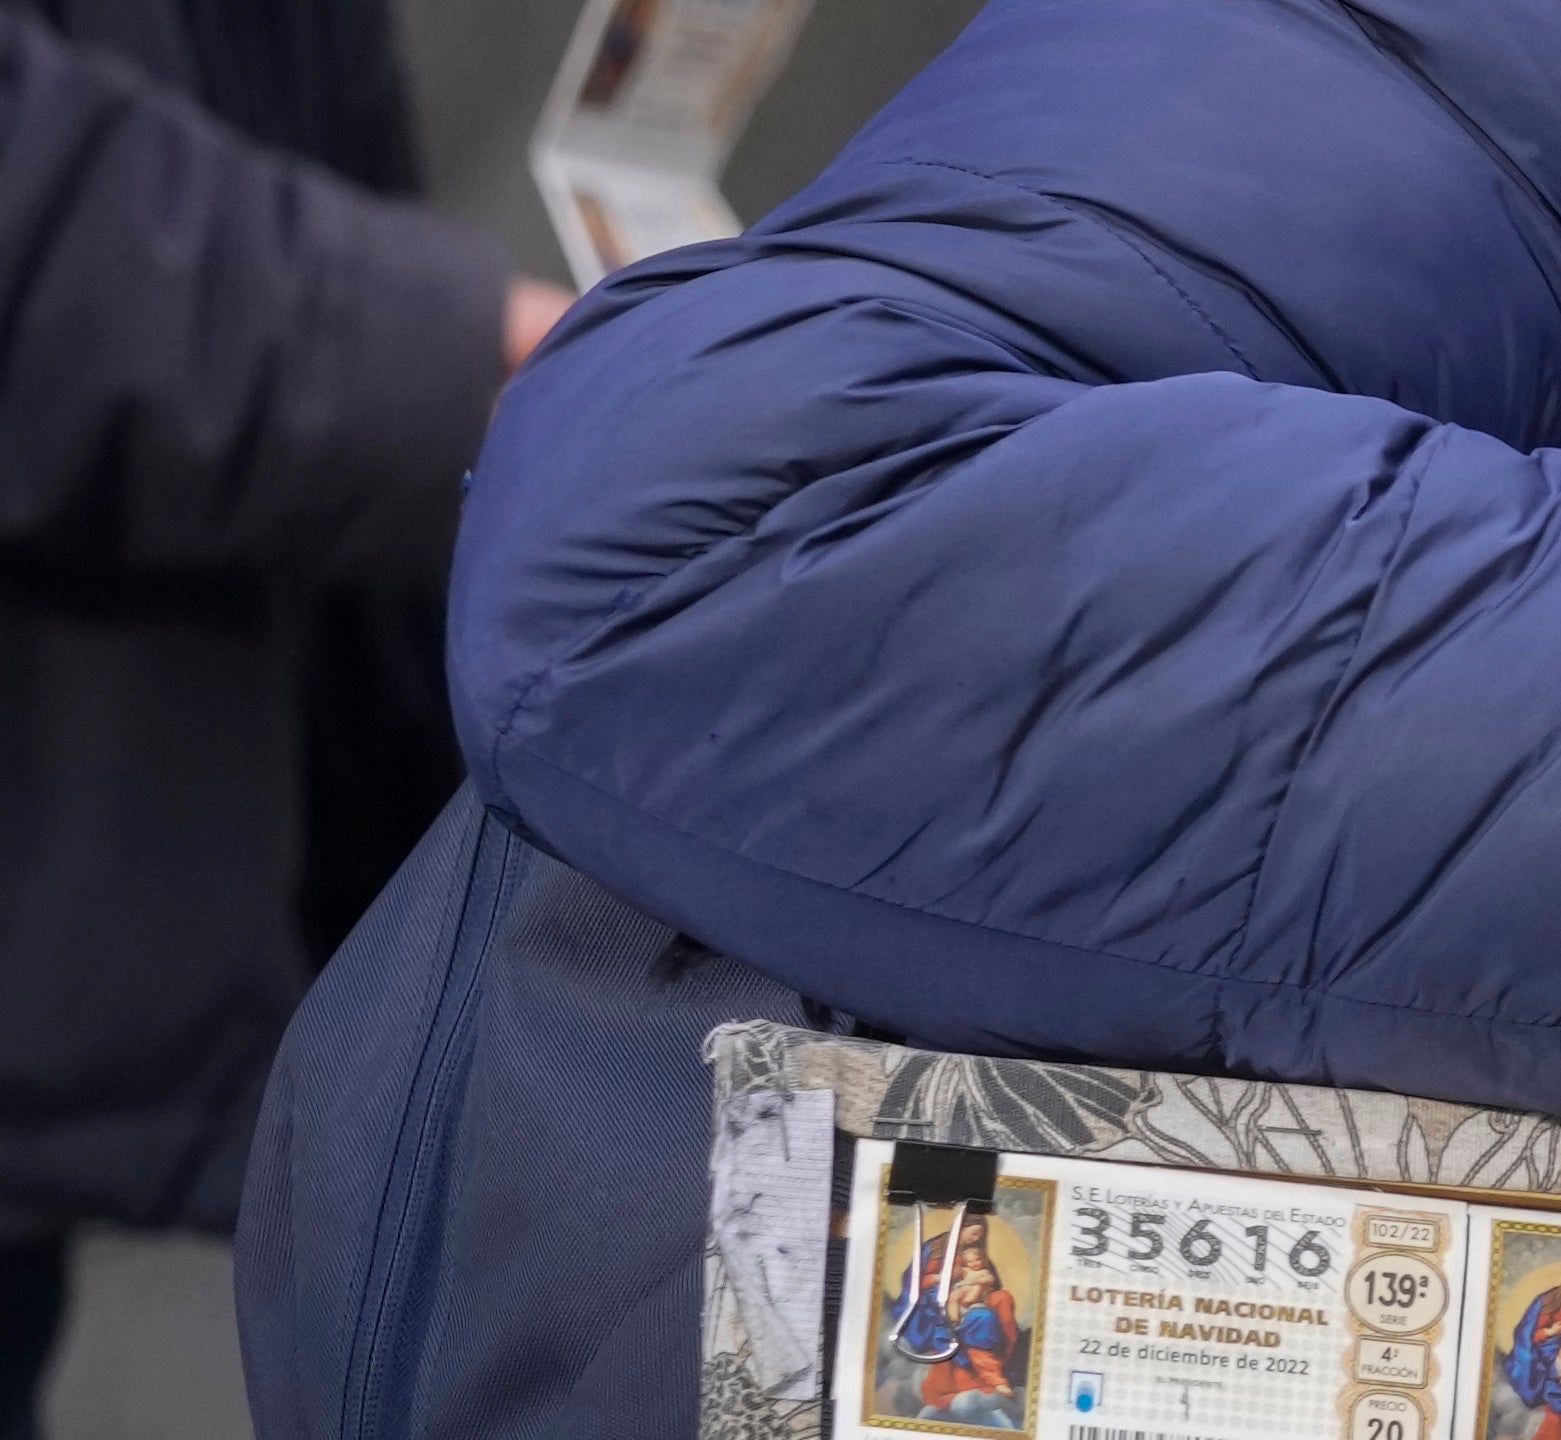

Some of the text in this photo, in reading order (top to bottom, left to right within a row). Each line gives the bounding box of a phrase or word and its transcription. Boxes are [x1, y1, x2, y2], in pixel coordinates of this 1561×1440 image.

[1072, 1207, 1331, 1277] 35616
[1070, 1286, 1329, 1326] LOTERÍA NACIONAL
[1115, 1318, 1281, 1348] DE NAVIDAD
